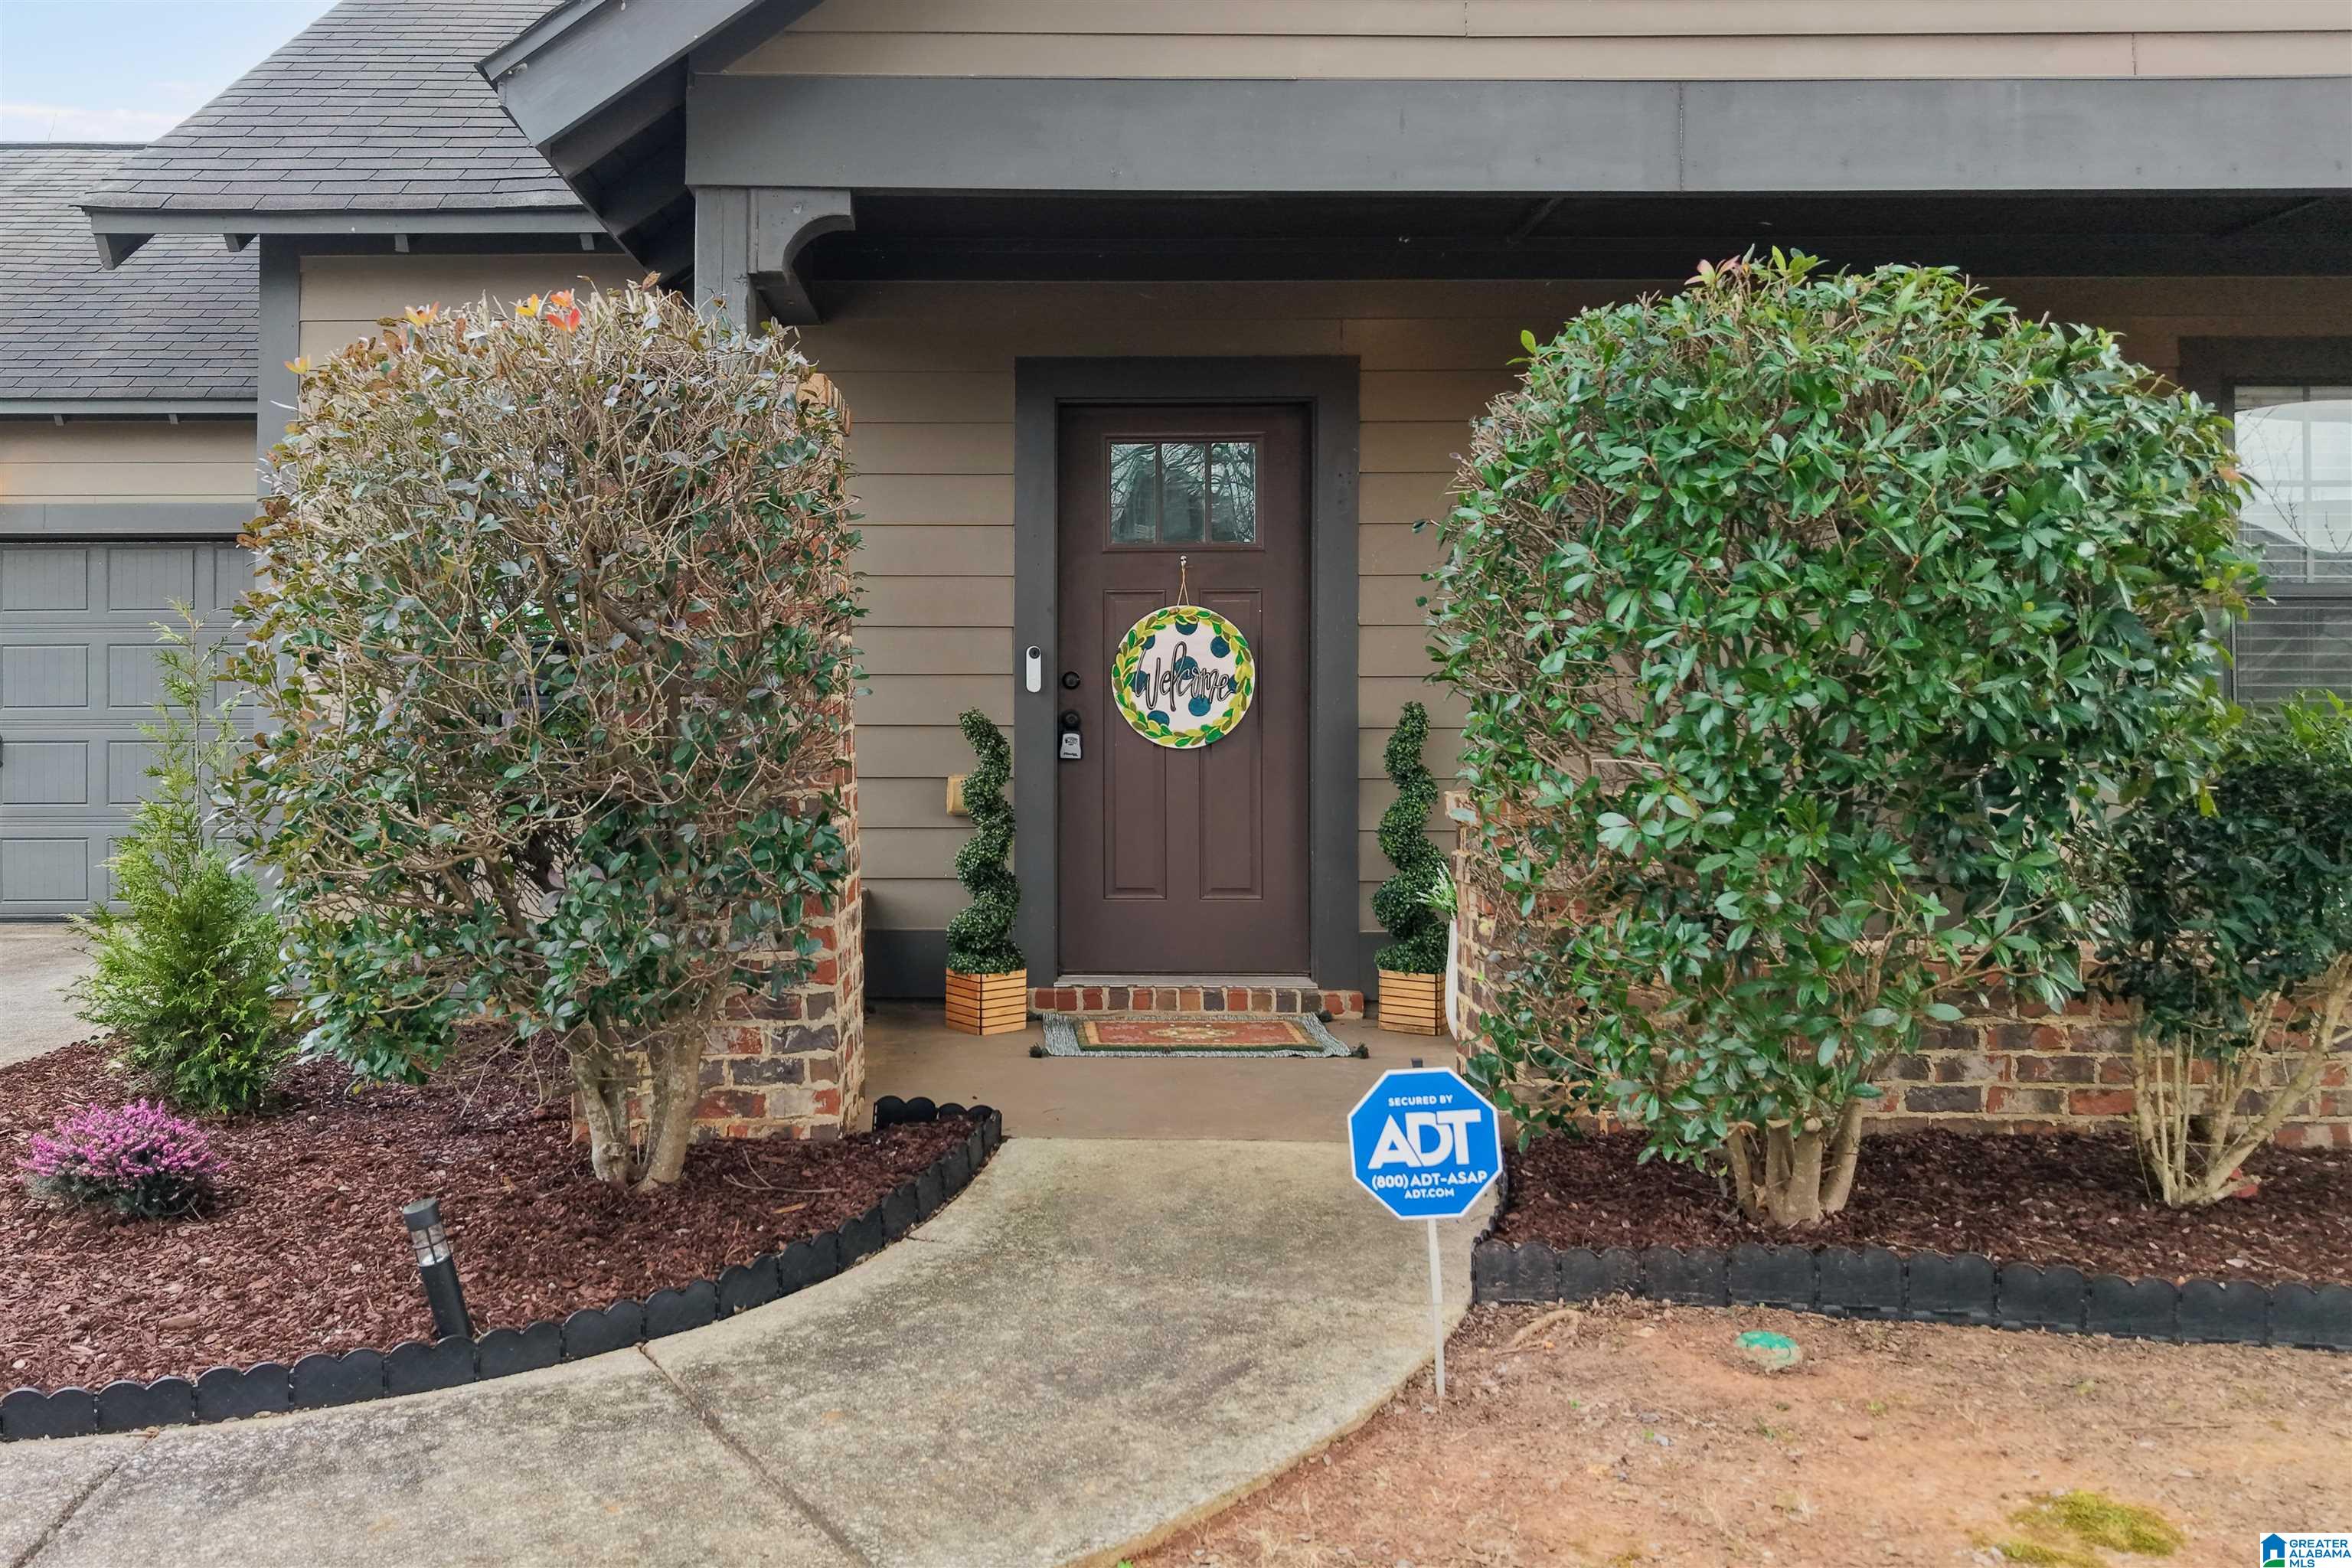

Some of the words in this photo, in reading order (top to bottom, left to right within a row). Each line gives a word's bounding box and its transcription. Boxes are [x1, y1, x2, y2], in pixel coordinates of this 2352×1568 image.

[1134, 641, 1236, 712] Welcome
[1388, 1095, 1437, 1107] SECURED
[1439, 1094, 1453, 1105] BY
[1367, 1109, 1481, 1170] ADT
[1371, 1174, 1409, 1190] (800)
[1410, 1170, 1488, 1187] ADT-ASAP
[1404, 1187, 1455, 1199] ADT.COM
